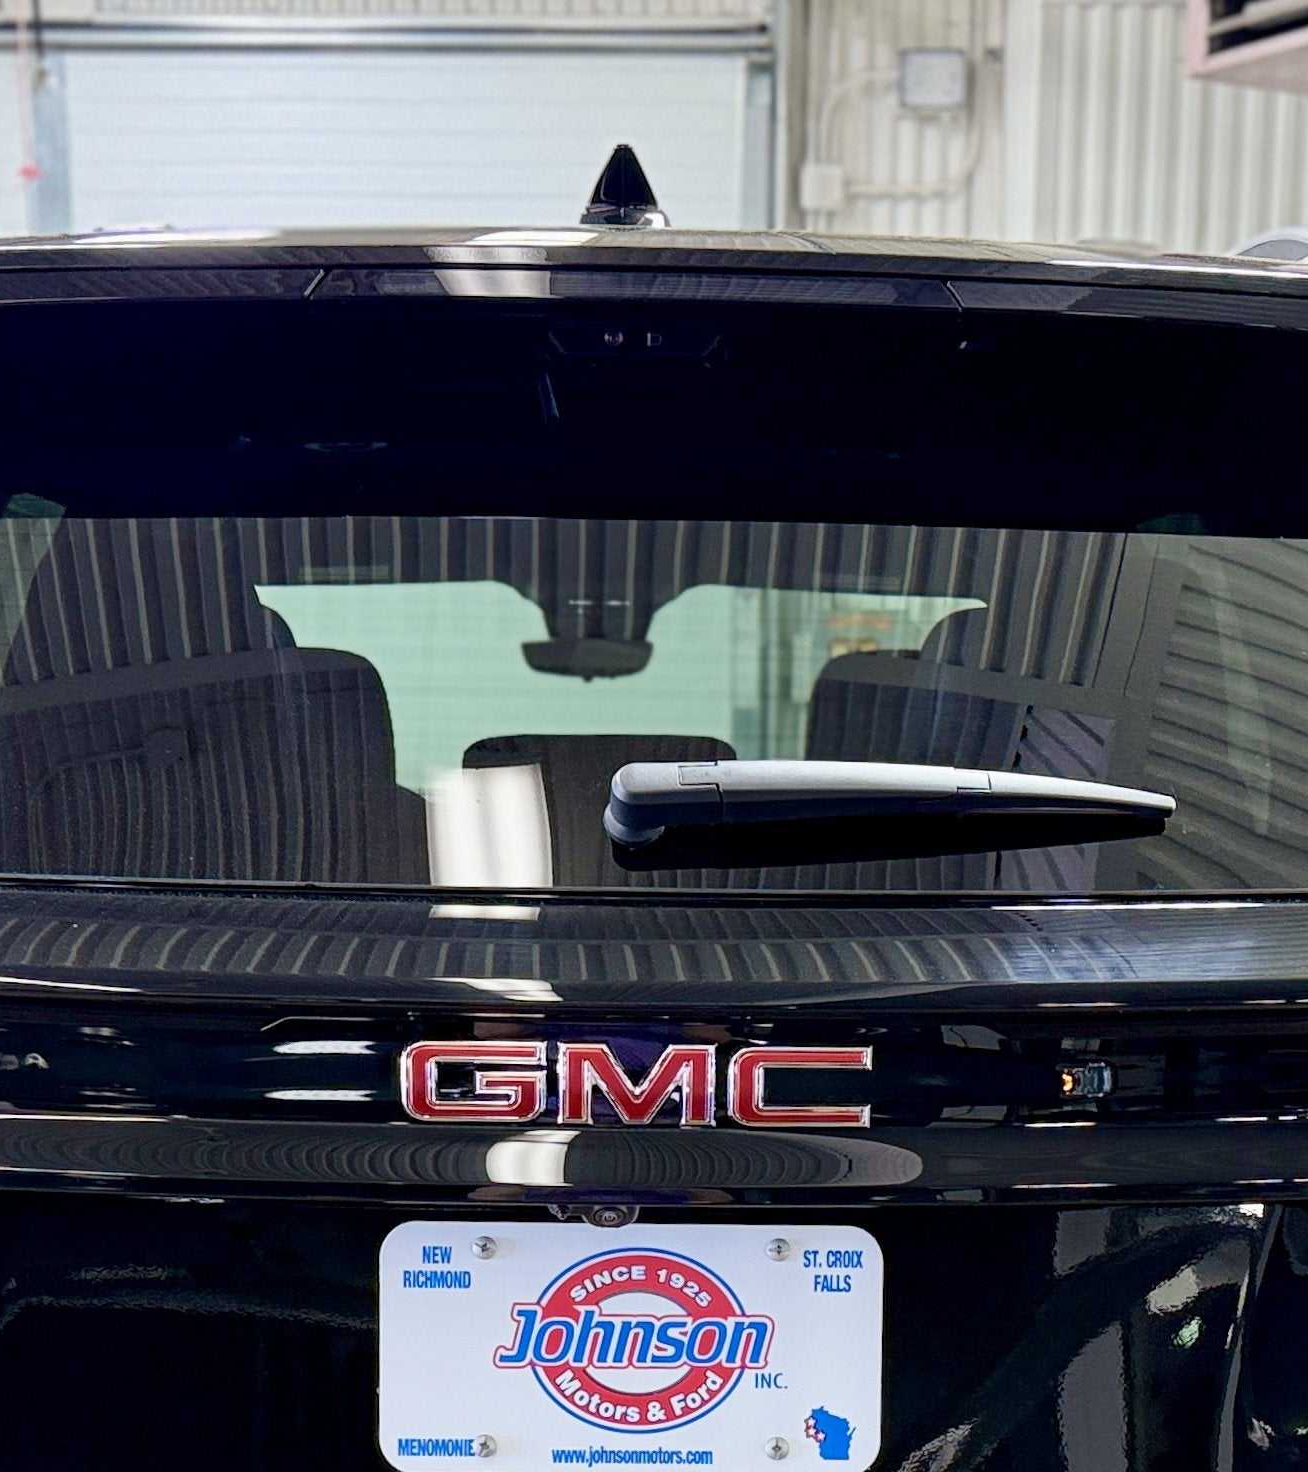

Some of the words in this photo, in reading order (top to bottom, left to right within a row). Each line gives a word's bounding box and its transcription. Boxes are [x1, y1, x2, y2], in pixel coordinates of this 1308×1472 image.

[399, 1041, 873, 1129] GMC
[422, 1246, 453, 1264] NEW
[803, 1249, 822, 1268] ST.
[826, 1249, 863, 1269] CROIX
[403, 1270, 472, 1289] RICHMOND
[569, 1265, 647, 1303] SINCE
[656, 1268, 713, 1308] 1925
[814, 1274, 852, 1293] FALLS
[499, 1309, 768, 1364] Johnson
[754, 1372, 789, 1390] INC.
[555, 1369, 641, 1423] Motors
[646, 1400, 667, 1422] &
[670, 1370, 725, 1417] Ford
[398, 1438, 475, 1457] MENOMONIE
[552, 1446, 713, 1468] www.johnsonmotors.com
